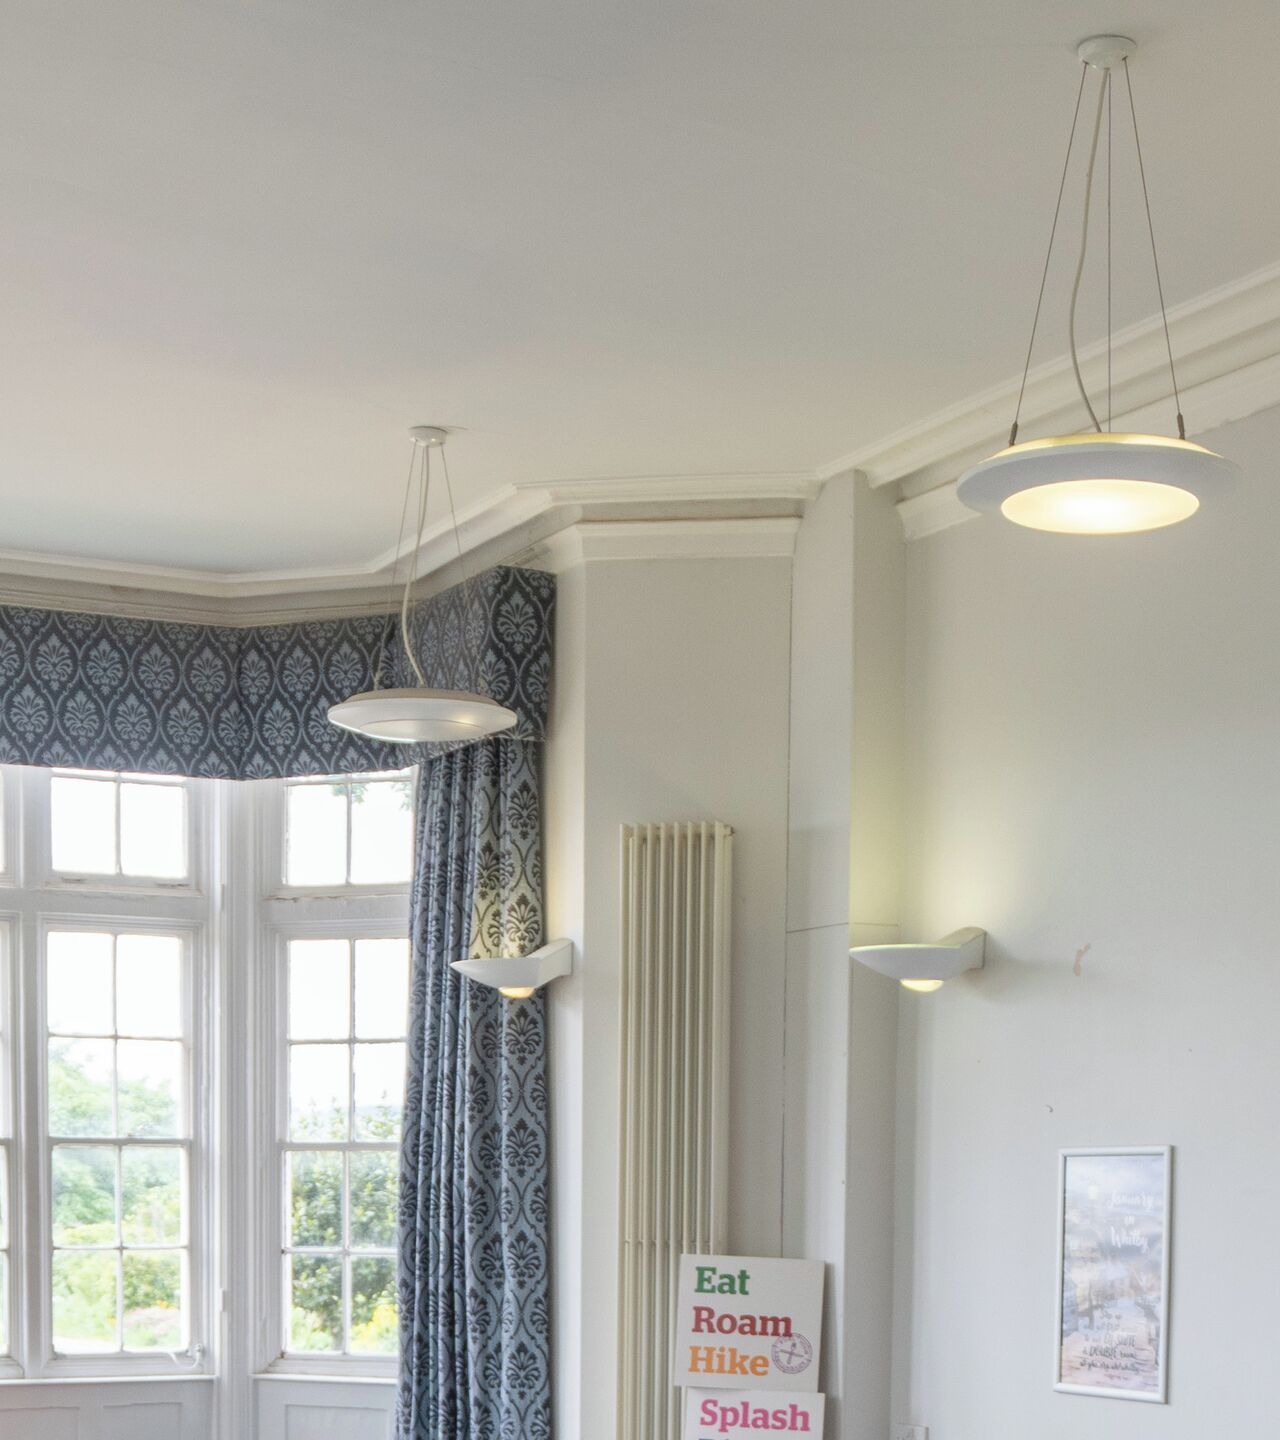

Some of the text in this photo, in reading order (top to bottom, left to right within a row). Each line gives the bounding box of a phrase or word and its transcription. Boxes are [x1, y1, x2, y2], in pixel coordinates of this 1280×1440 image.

[694, 1266, 750, 1295] Eat
[691, 1305, 792, 1337] Roam
[688, 1345, 769, 1376] Hike
[699, 1399, 811, 1433] Splash
